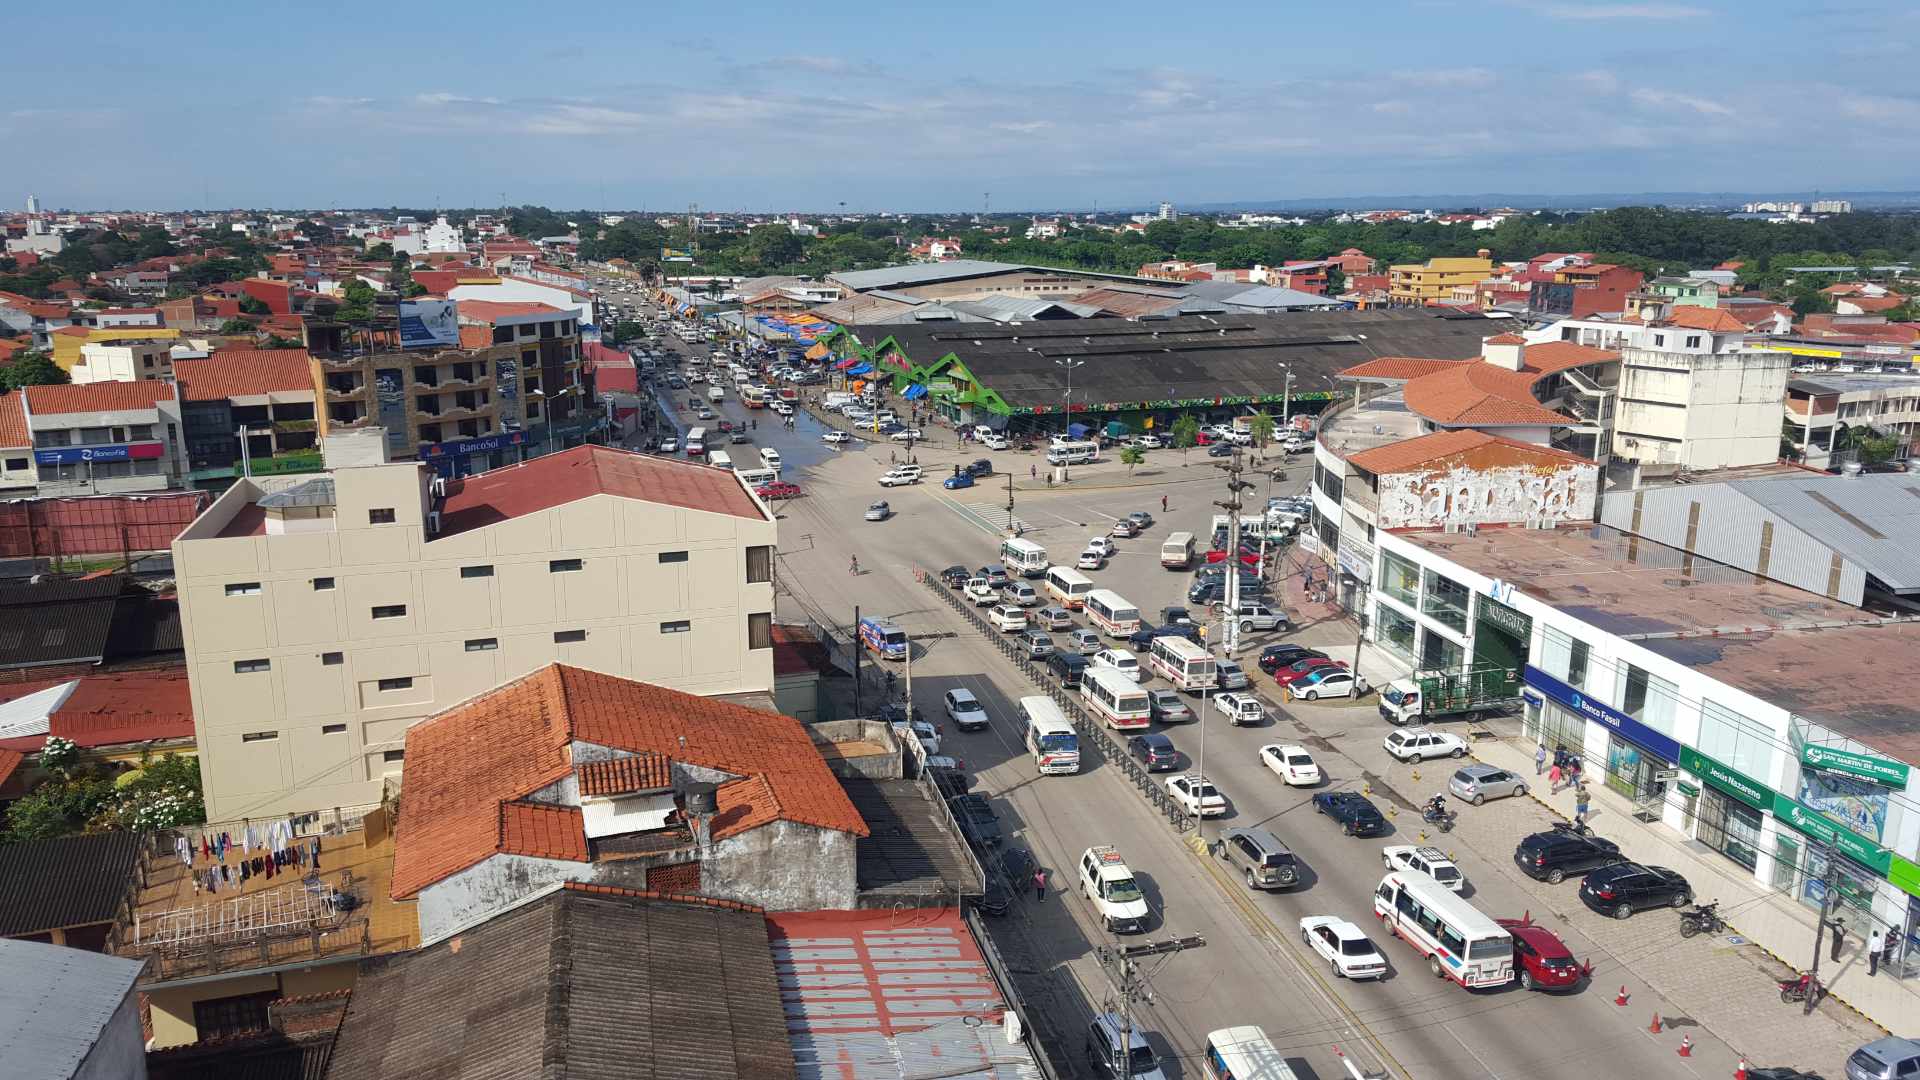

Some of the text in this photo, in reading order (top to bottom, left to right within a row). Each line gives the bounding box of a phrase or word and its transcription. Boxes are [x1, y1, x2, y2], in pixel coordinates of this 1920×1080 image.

[459, 438, 499, 453] BancoSol
[1581, 700, 1620, 728] Banco Fassil
[1823, 754, 1835, 762] SAN
[1873, 765, 1899, 776] PORRES
[1710, 767, 1761, 800] Jesús Nazareno
